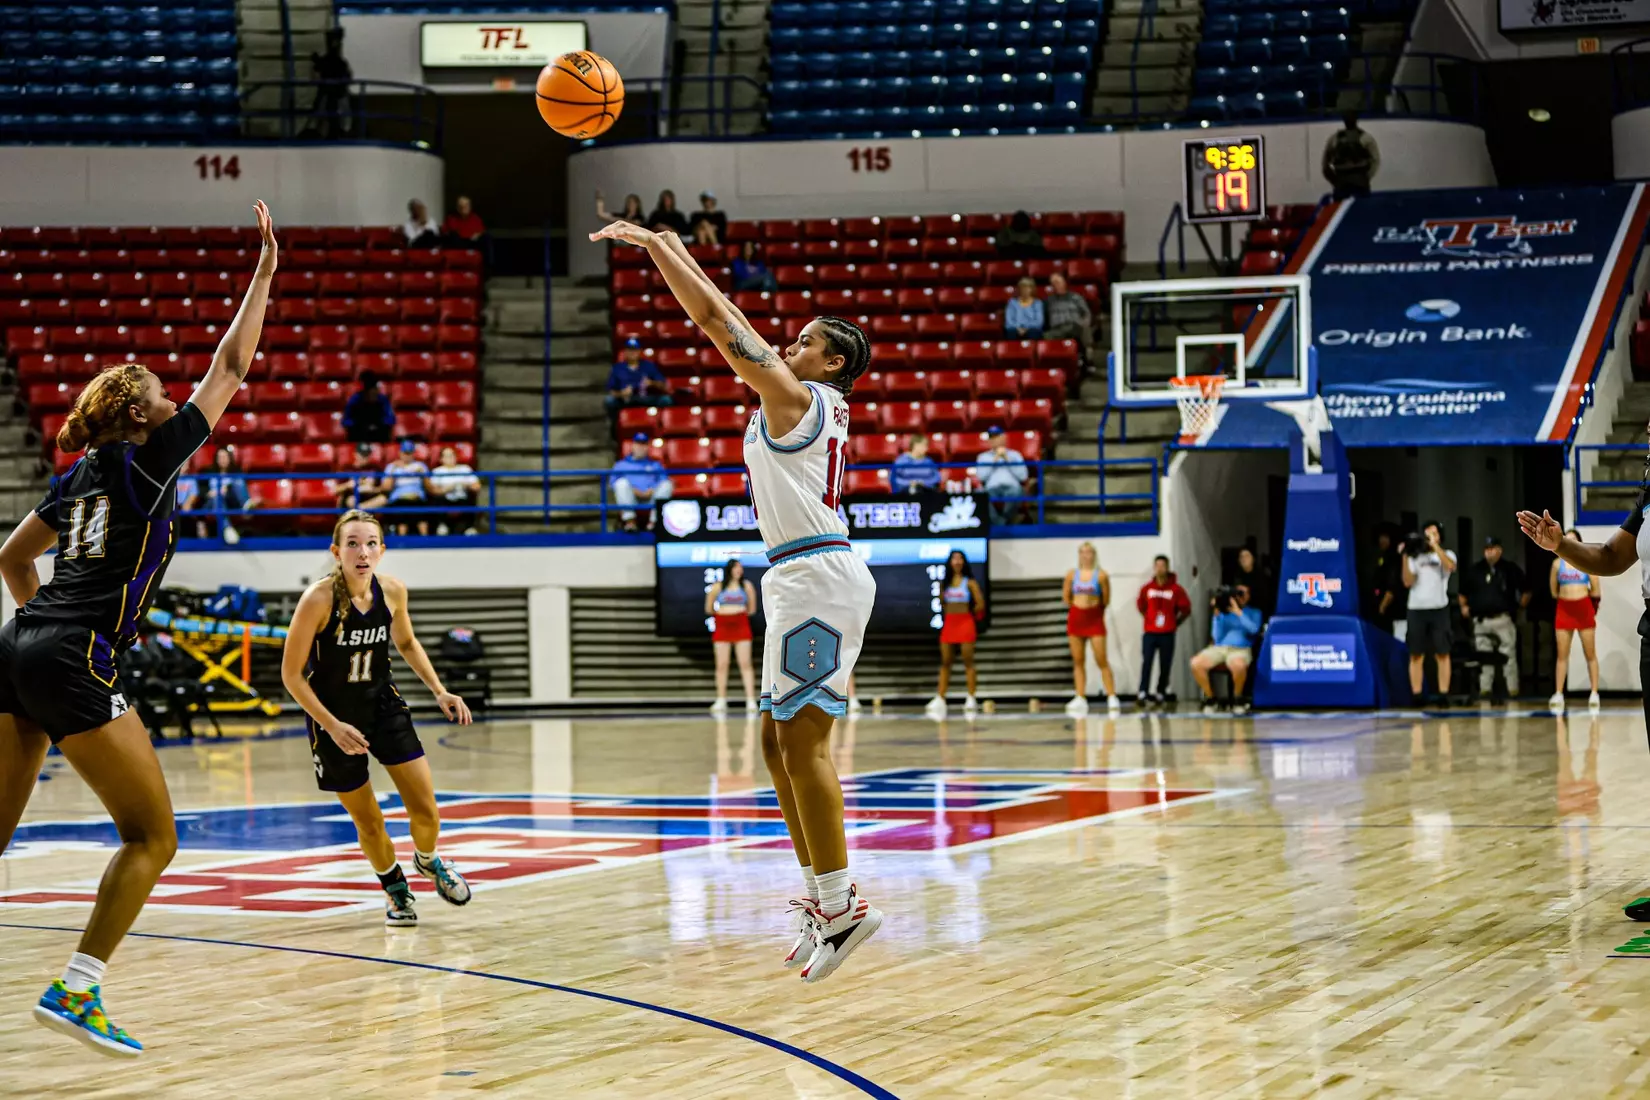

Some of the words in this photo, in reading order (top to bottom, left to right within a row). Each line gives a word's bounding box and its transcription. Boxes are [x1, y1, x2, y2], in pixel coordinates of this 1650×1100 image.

[479, 27, 530, 49] TFL
[194, 154, 242, 181] 114
[846, 146, 891, 173] 115
[1205, 145, 1256, 171] 9:36
[1215, 171, 1249, 211] 19
[1322, 261, 1441, 275] PREMIER
[1446, 253, 1595, 272] PARTNERS
[1319, 328, 1427, 349] Origin
[1440, 322, 1526, 343] Bank
[1325, 393, 1391, 407] thern
[1396, 390, 1506, 404] Louisiana
[1397, 402, 1481, 416] Center
[63, 495, 111, 560] 14
[849, 501, 922, 529] TECH
[336, 625, 388, 646] LSUA
[347, 649, 374, 683] 11
